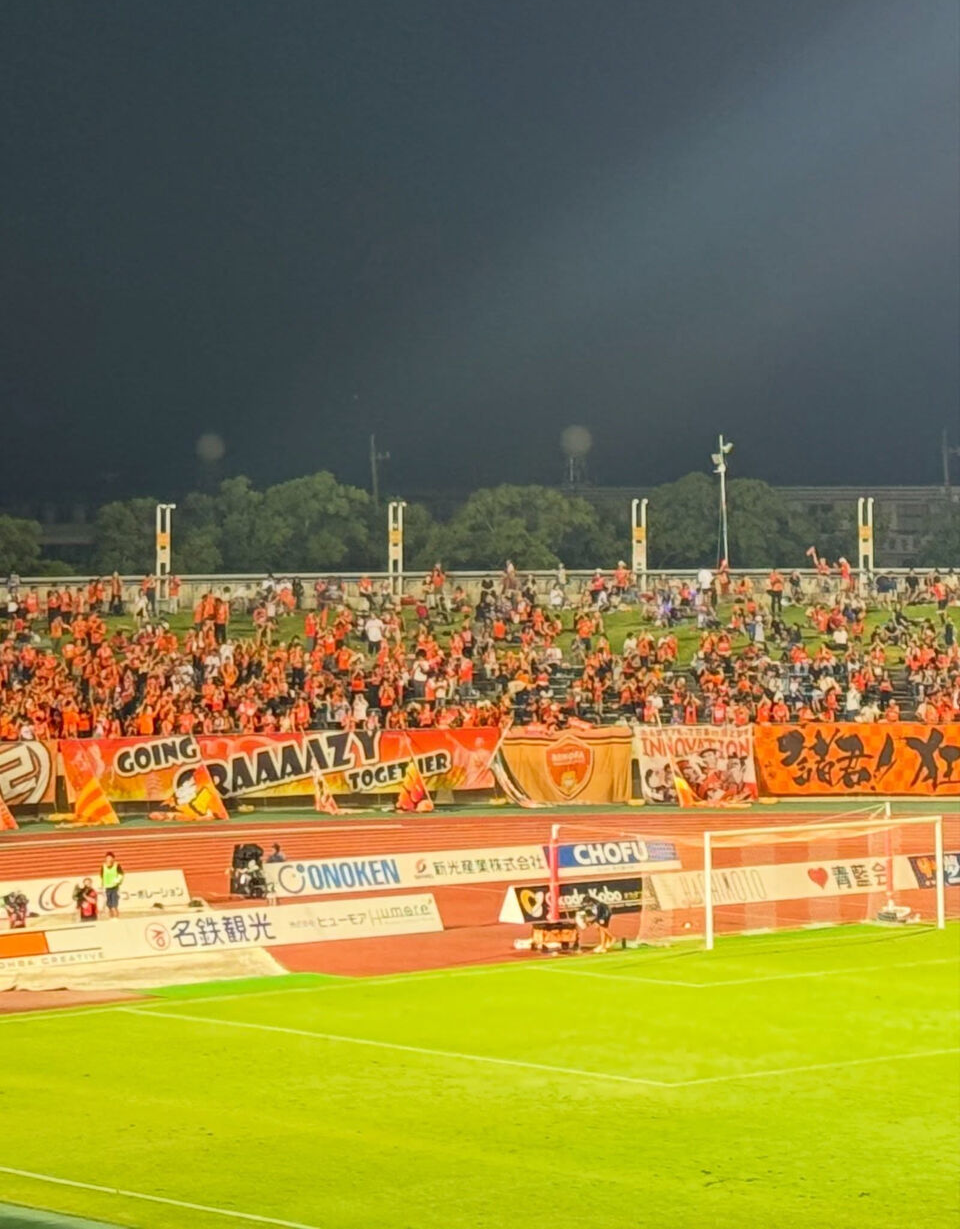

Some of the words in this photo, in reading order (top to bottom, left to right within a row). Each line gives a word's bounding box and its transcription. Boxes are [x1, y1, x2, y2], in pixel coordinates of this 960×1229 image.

[117, 737, 197, 773] GOING
[640, 736, 751, 759] INNOVATION
[433, 854, 544, 875] 新光産業株式会社
[573, 841, 648, 865] CHOFU
[307, 859, 401, 890] ONOKEN
[171, 912, 276, 947] 名鉄観光
